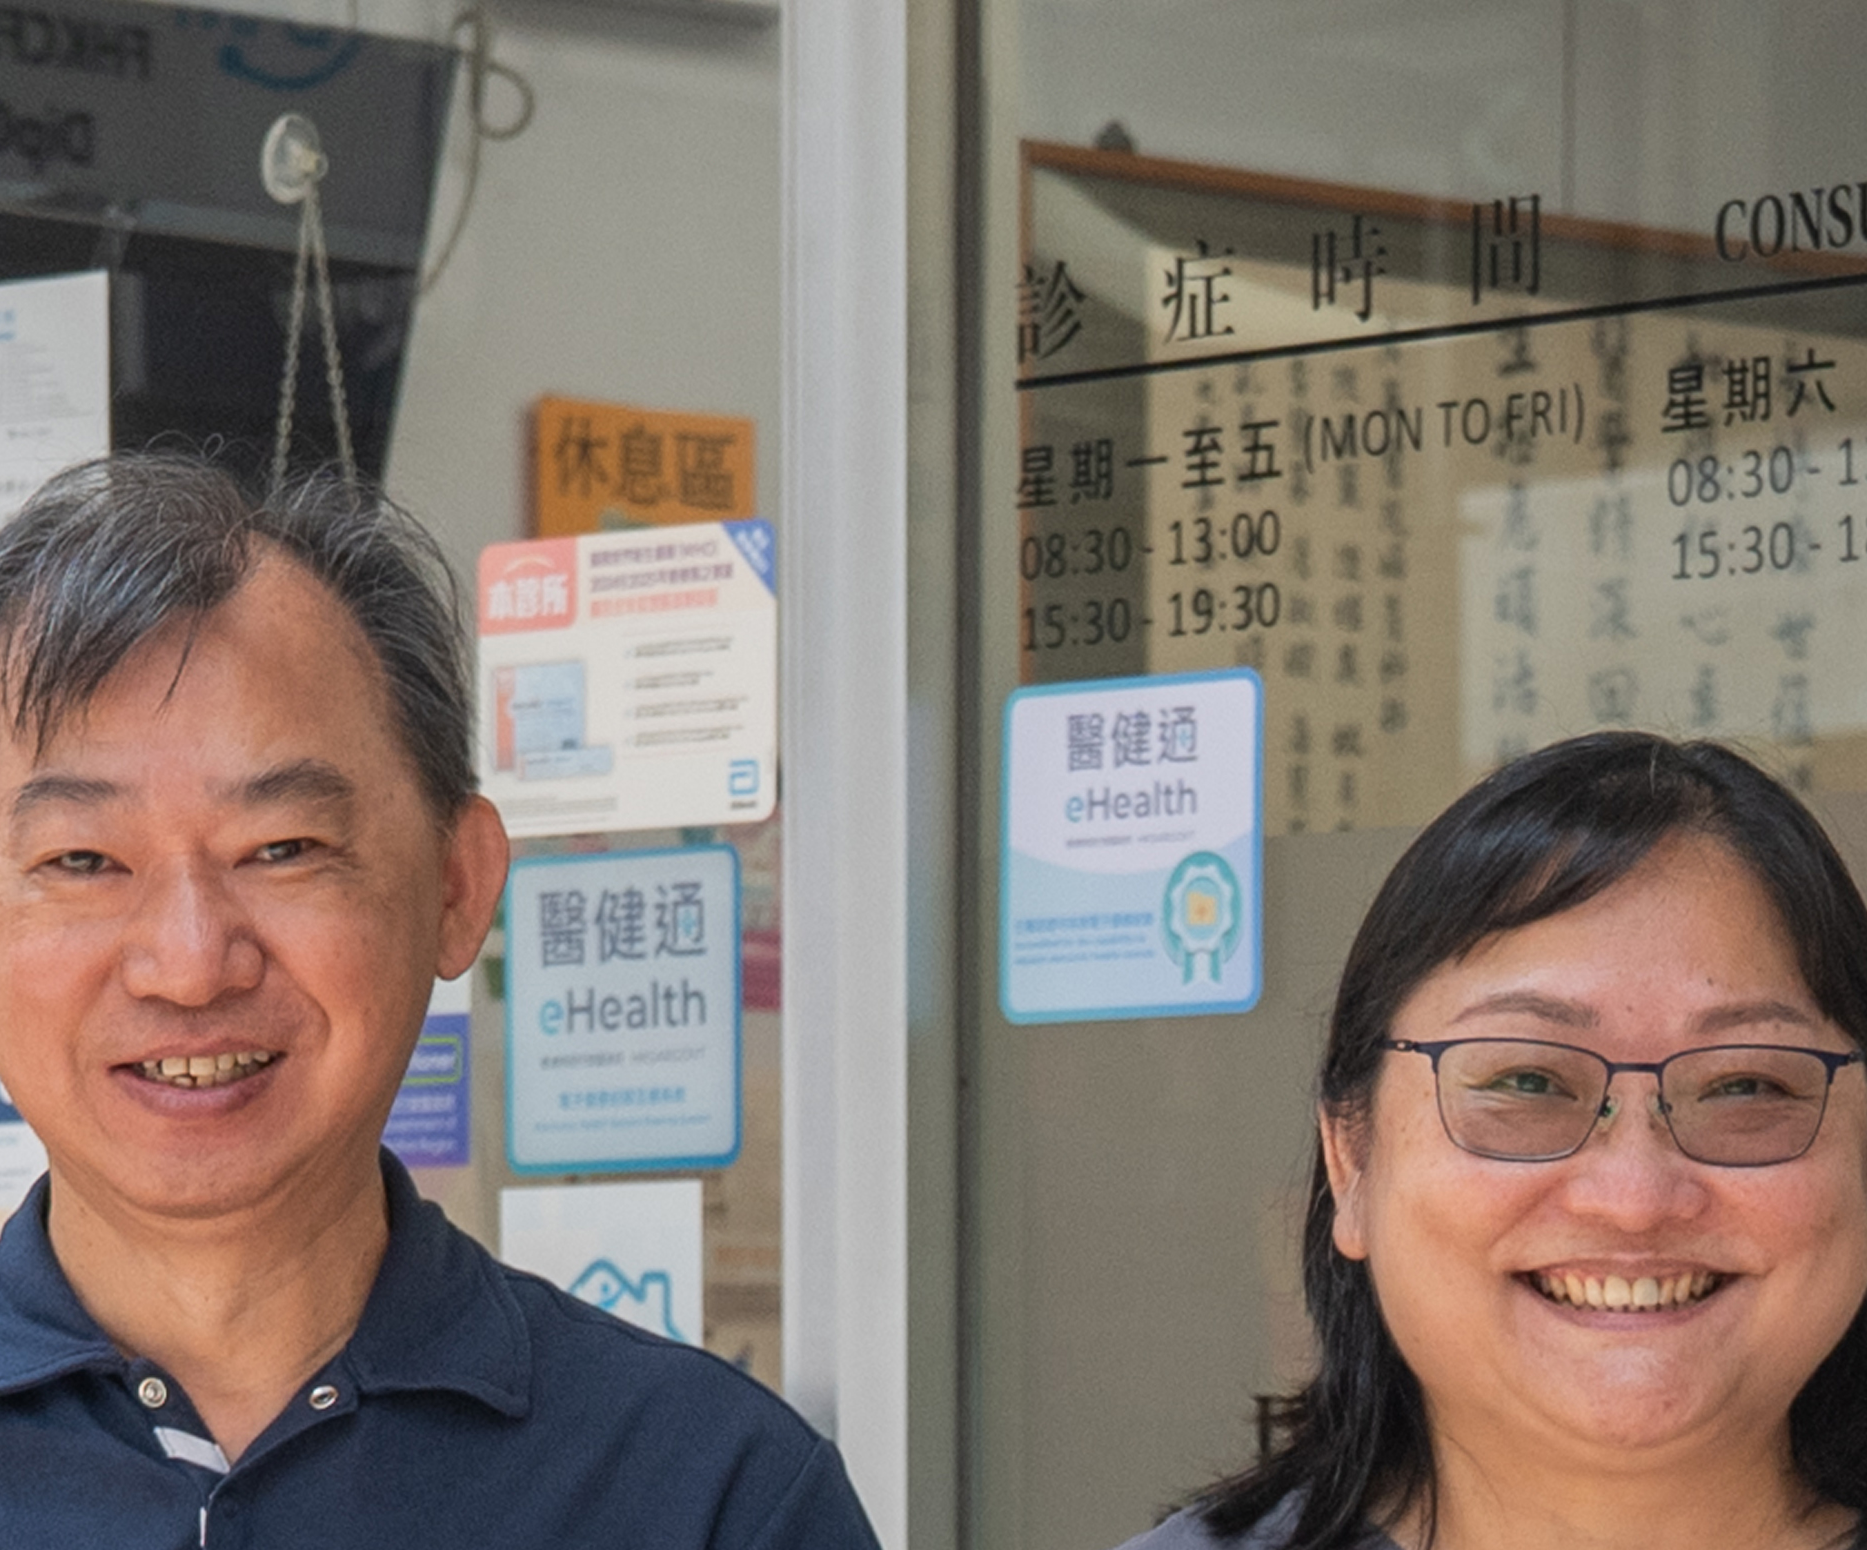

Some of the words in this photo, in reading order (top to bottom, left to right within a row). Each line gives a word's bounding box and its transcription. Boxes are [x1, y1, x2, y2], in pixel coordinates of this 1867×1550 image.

[1017, 195, 1541, 365] 診症時間
[1661, 348, 1837, 434] 星期六
[553, 416, 736, 511] 休息區
[1017, 420, 1282, 510] 星期一至五
[1303, 407, 1423, 474] (MON
[1439, 398, 1491, 448] TO
[1507, 384, 1585, 442] FRI)
[1667, 446, 1795, 507] 08:30
[1020, 527, 1131, 582] 08:30
[1169, 510, 1282, 567] 13:00
[1671, 522, 1795, 580] 15:30
[1022, 599, 1131, 652] 15:30
[1169, 582, 1282, 638] 19:30
[1065, 779, 1198, 823] eHealth
[538, 881, 708, 968] 醫健通
[539, 978, 708, 1036] eHealth
